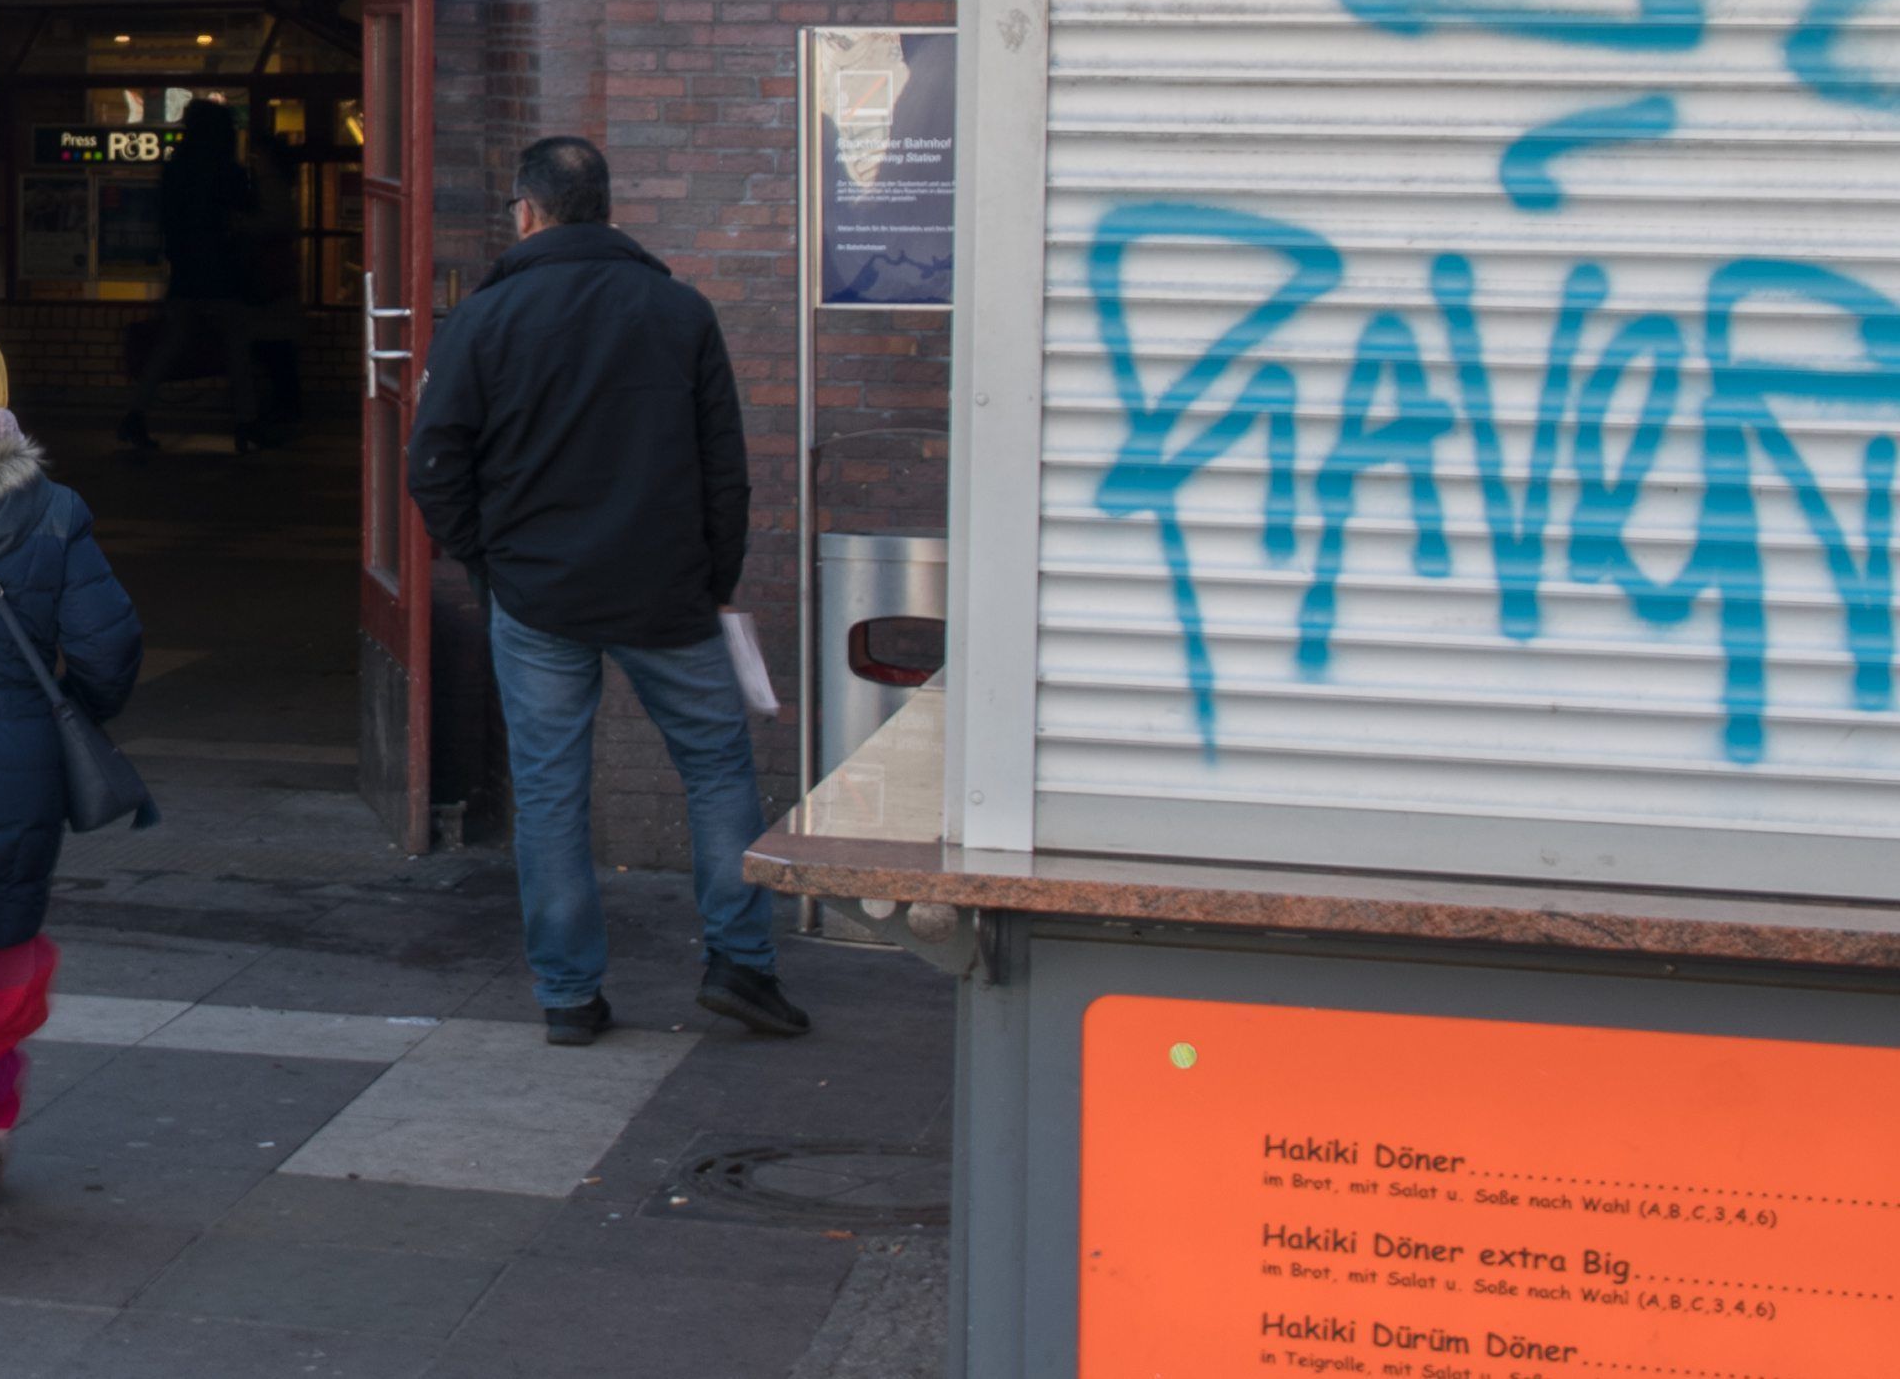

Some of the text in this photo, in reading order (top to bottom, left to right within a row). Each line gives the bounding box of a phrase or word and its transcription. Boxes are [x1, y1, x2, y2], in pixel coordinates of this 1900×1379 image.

[61, 132, 97, 147] Press
[108, 132, 160, 161] P&B
[904, 137, 952, 149] Bahnhof
[905, 152, 941, 163] Station
[1263, 1134, 1466, 1174] Hakiki Döner
[1262, 1172, 1284, 1187] im
[1291, 1173, 1340, 1194] Brot,
[1349, 1179, 1379, 1195] mit
[1388, 1182, 1438, 1200] Salat
[1445, 1190, 1464, 1203] u.
[1474, 1188, 1520, 1206] Soße
[1528, 1193, 1573, 1210] nach
[1581, 1196, 1631, 1214] Wahl
[1261, 1223, 1632, 1286] Hakiki Döner extra Big
[1260, 1260, 1283, 1276] im
[1290, 1261, 1339, 1284] Brot,
[1347, 1269, 1378, 1284] mit
[1387, 1271, 1437, 1289] Salat
[1444, 1279, 1463, 1292] u.
[1473, 1278, 1518, 1297] Soße
[1527, 1283, 1571, 1301] nach
[1580, 1287, 1629, 1305] Wahl
[1260, 1312, 1579, 1364] Hakiki Dürüm Döner
[1260, 1349, 1276, 1365] in
[1284, 1350, 1373, 1376] Teigrolle,
[1382, 1362, 1413, 1378] mit
